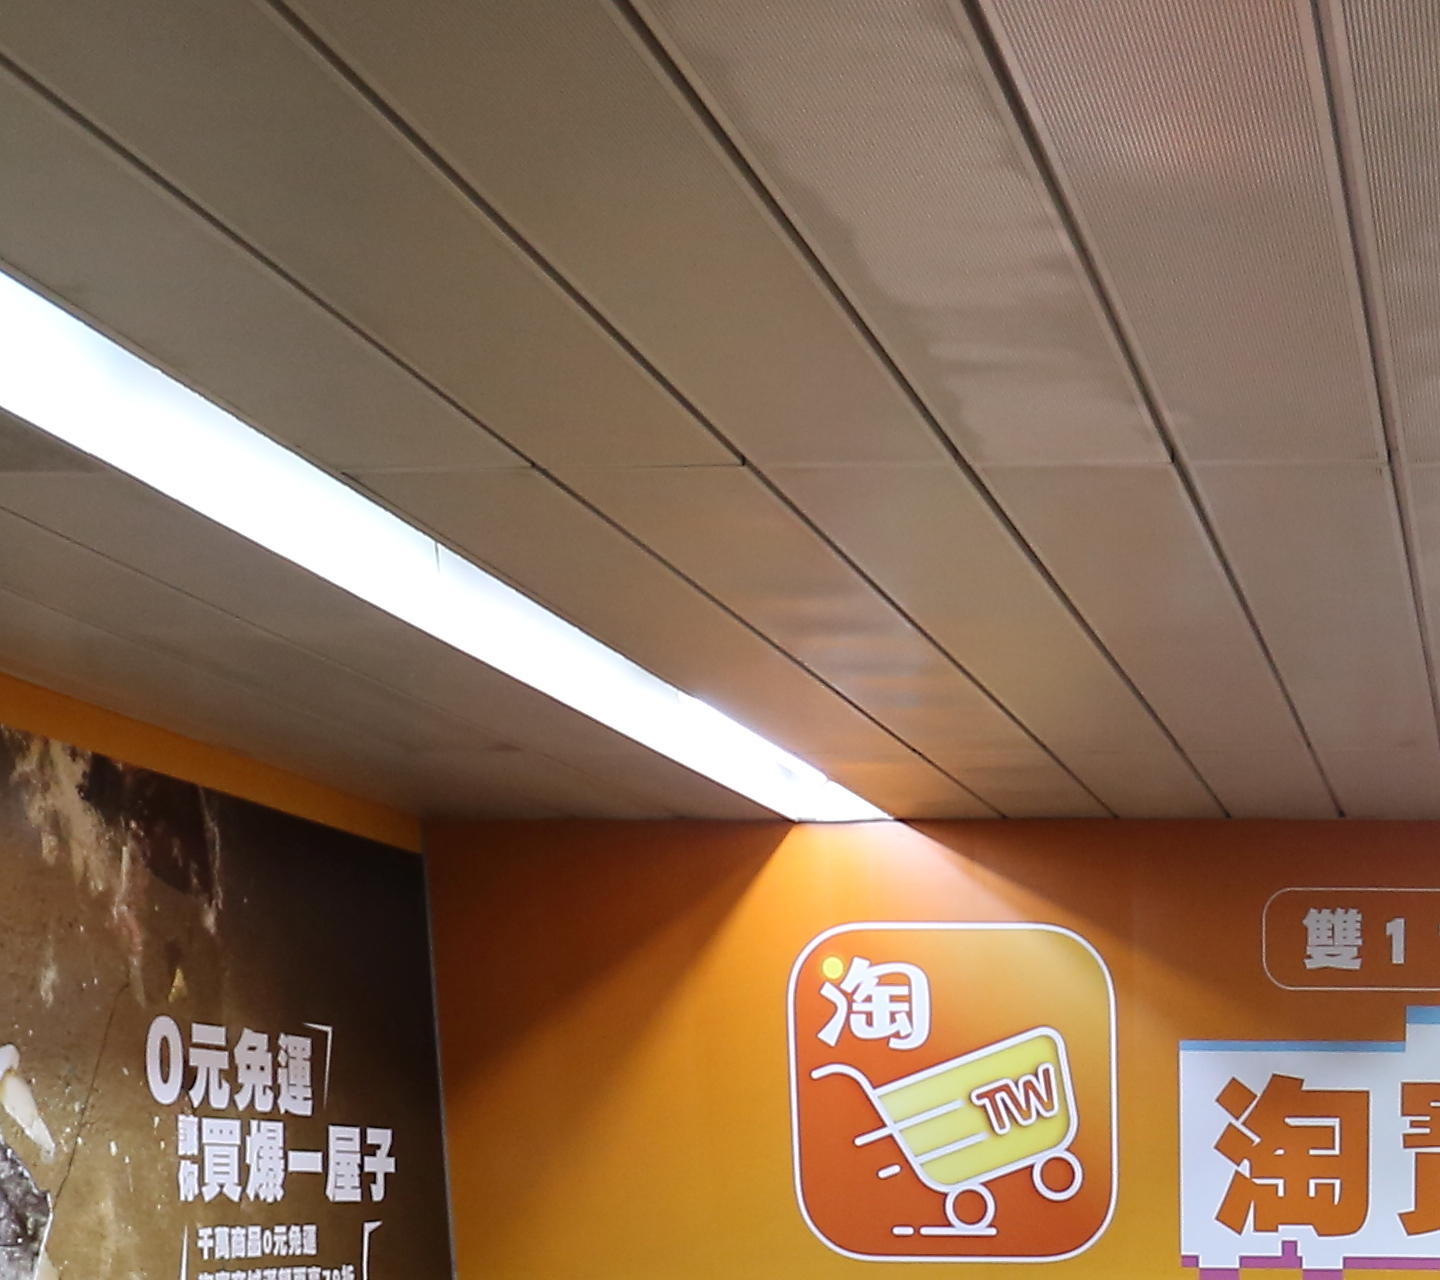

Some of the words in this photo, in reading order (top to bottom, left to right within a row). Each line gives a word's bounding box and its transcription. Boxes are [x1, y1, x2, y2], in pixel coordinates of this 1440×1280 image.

[820, 957, 933, 1051] 淘
[146, 1015, 313, 1116] 0元免運
[970, 1063, 1058, 1137] TW
